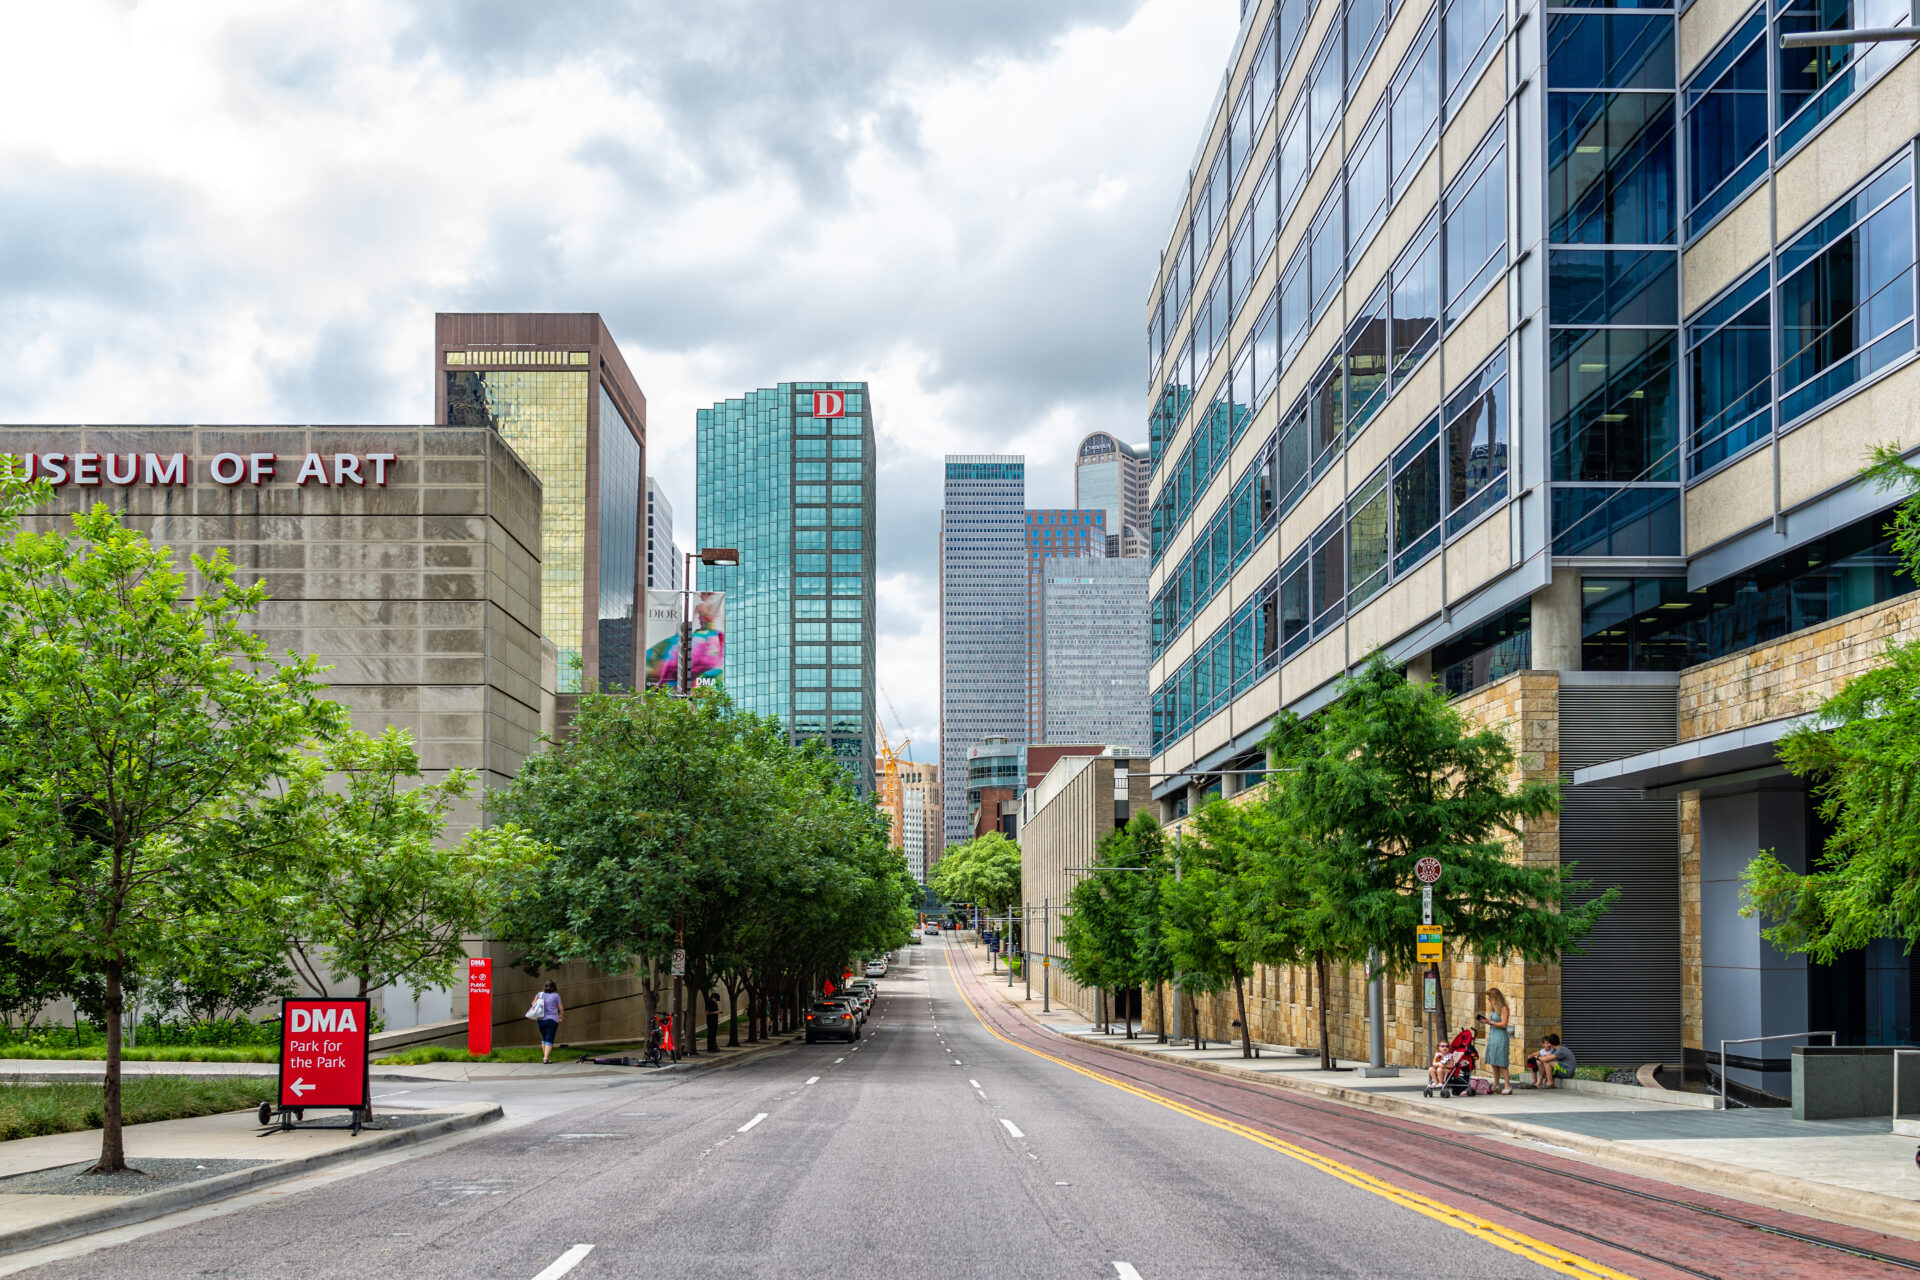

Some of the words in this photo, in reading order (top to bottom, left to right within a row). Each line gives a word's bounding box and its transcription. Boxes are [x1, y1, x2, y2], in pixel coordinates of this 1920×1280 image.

[815, 392, 842, 416] D
[211, 453, 276, 485] OF
[297, 452, 398, 486] ART
[648, 608, 678, 619] DIOR
[696, 678, 716, 686] DMA
[291, 1009, 357, 1032] DMA
[290, 1040, 319, 1052] Park
[323, 1039, 342, 1054] for
[290, 1056, 312, 1068] the
[316, 1056, 346, 1068] Park
